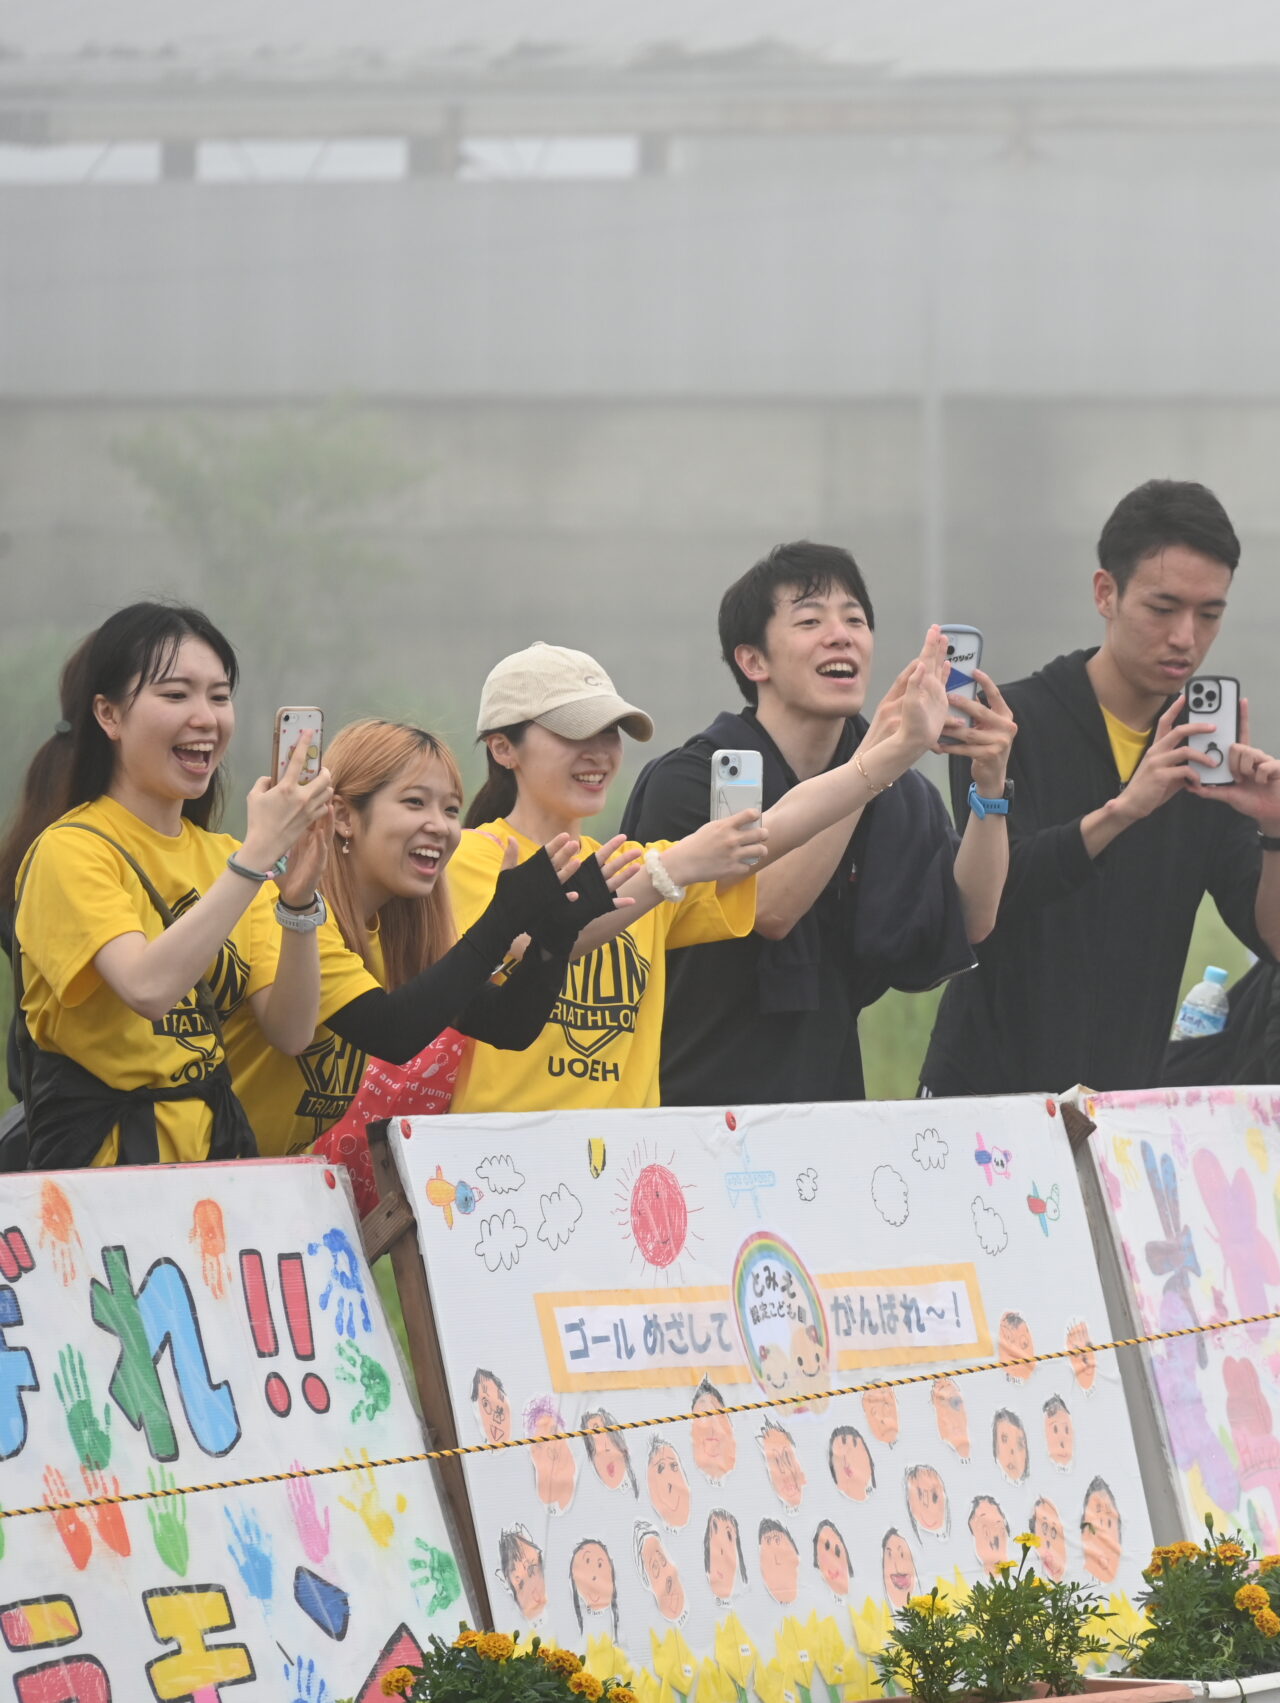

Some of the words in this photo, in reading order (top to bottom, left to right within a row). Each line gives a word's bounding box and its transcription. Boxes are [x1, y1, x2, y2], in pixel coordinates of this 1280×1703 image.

[549, 1002, 636, 1029] RIATHLO
[548, 1055, 620, 1082] UOEH
[564, 1317, 636, 1360] ゴール
[643, 1311, 733, 1355] めざして
